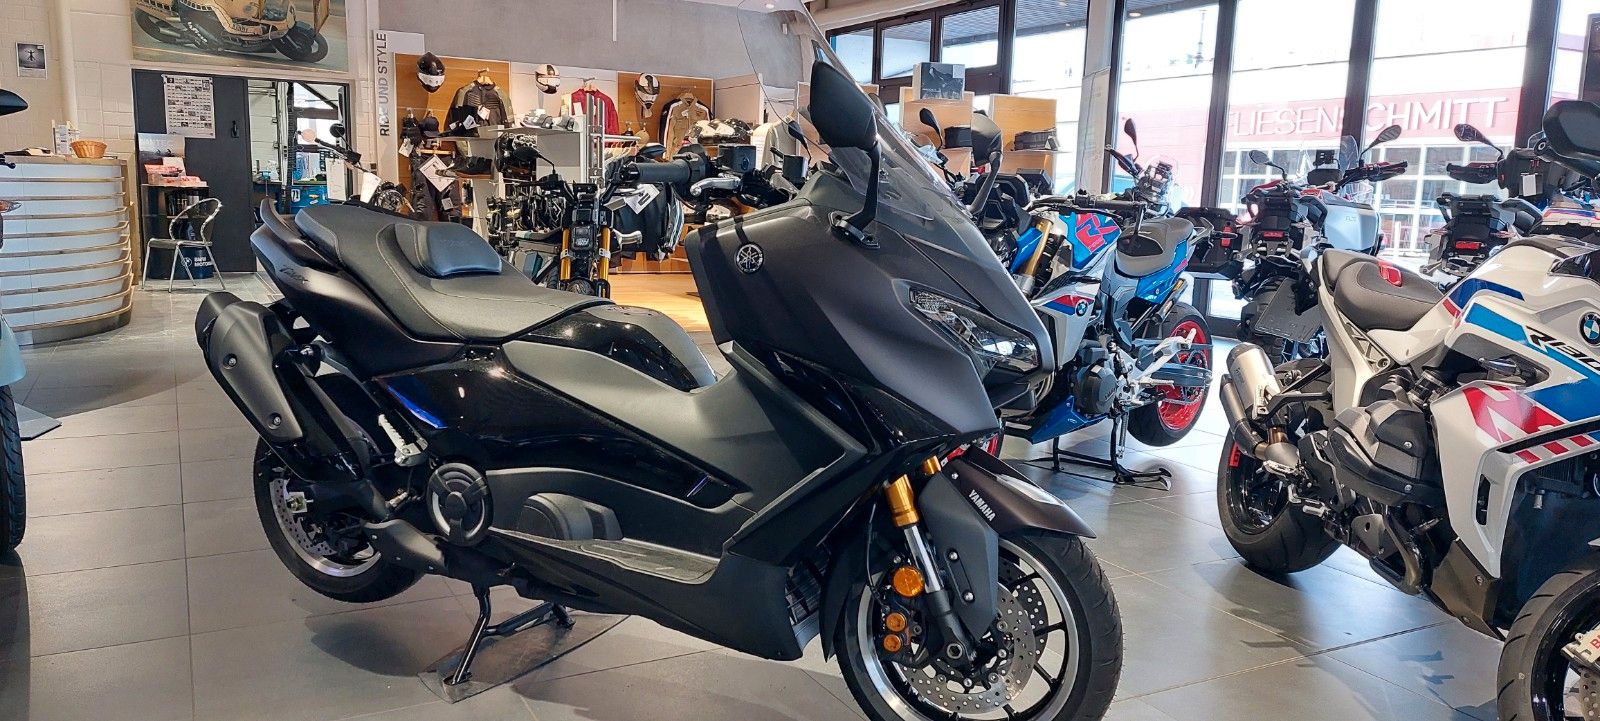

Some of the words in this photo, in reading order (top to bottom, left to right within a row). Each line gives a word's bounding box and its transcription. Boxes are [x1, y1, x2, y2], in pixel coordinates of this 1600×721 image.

[376, 32, 388, 74] STYLE
[378, 79, 389, 104] UND
[969, 489, 996, 521] YAMAHA
